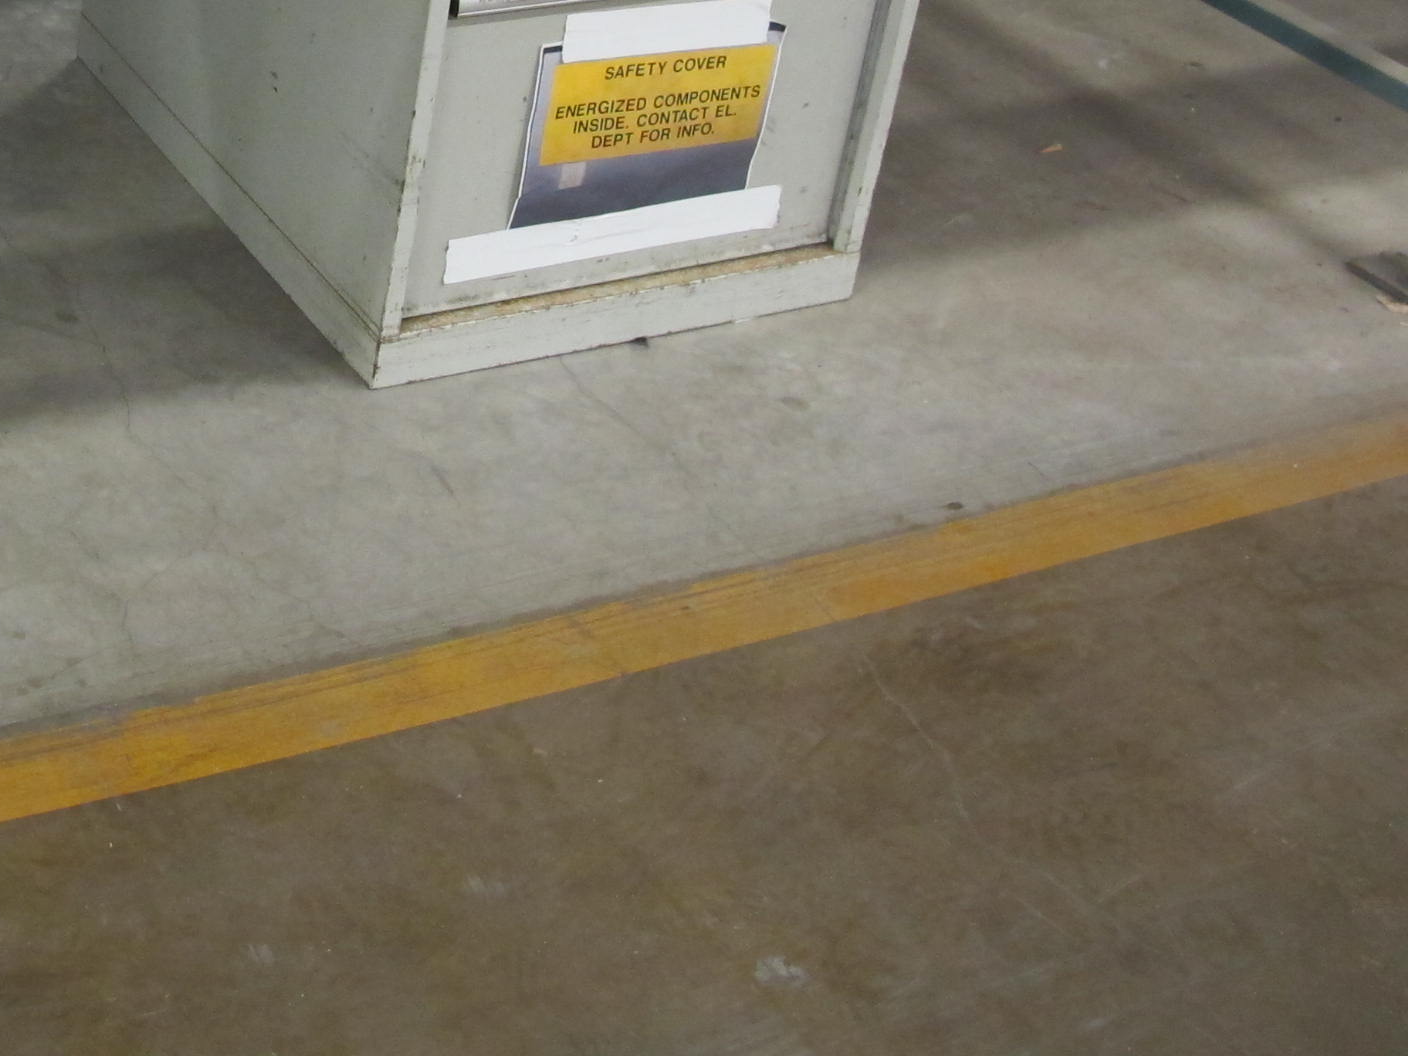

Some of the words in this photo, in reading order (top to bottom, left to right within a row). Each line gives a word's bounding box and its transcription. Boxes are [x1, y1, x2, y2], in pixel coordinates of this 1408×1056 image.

[605, 61, 668, 80] SAFETY
[673, 55, 727, 73] COVER
[555, 97, 647, 120] ENERGIZED
[653, 85, 761, 109] COMPONENTS
[573, 115, 630, 134] INSIDE.
[636, 107, 708, 128] CONTACT
[715, 104, 737, 119] EL.
[591, 132, 633, 149] DEPT
[640, 127, 670, 144] FOR
[677, 123, 714, 139] INFO.
